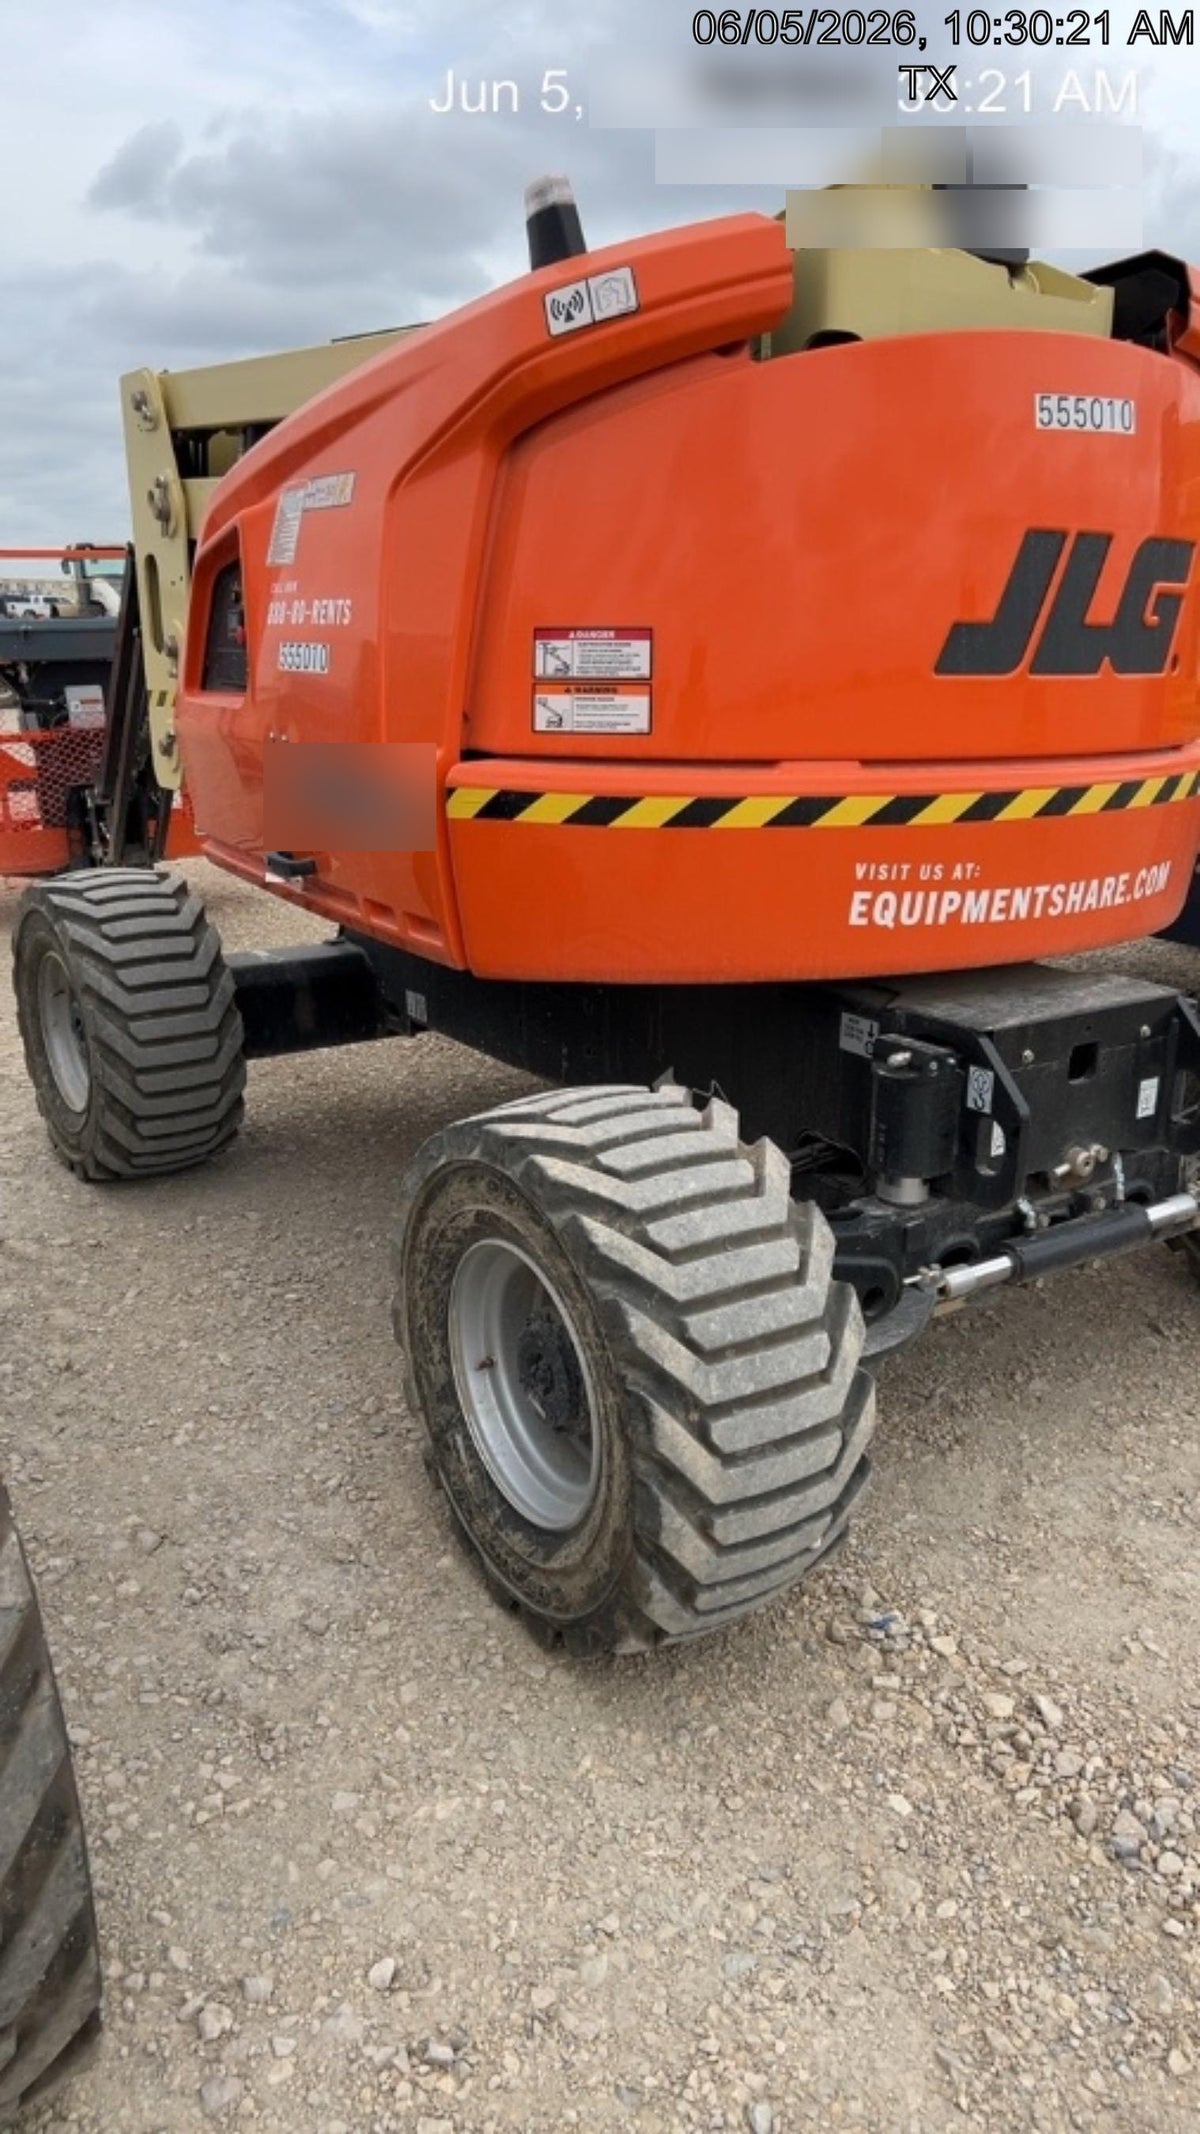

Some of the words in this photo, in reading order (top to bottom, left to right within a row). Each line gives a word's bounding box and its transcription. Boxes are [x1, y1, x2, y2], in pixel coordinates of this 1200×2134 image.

[1038, 395, 1132, 431] 555010
[933, 528, 1197, 676] JLG
[281, 644, 328, 671] 555010
[855, 862, 911, 881] VISIT
[919, 863, 944, 881] US
[951, 862, 981, 880] AT:
[848, 860, 1173, 930] EQUIPMENTSHARE.COM
